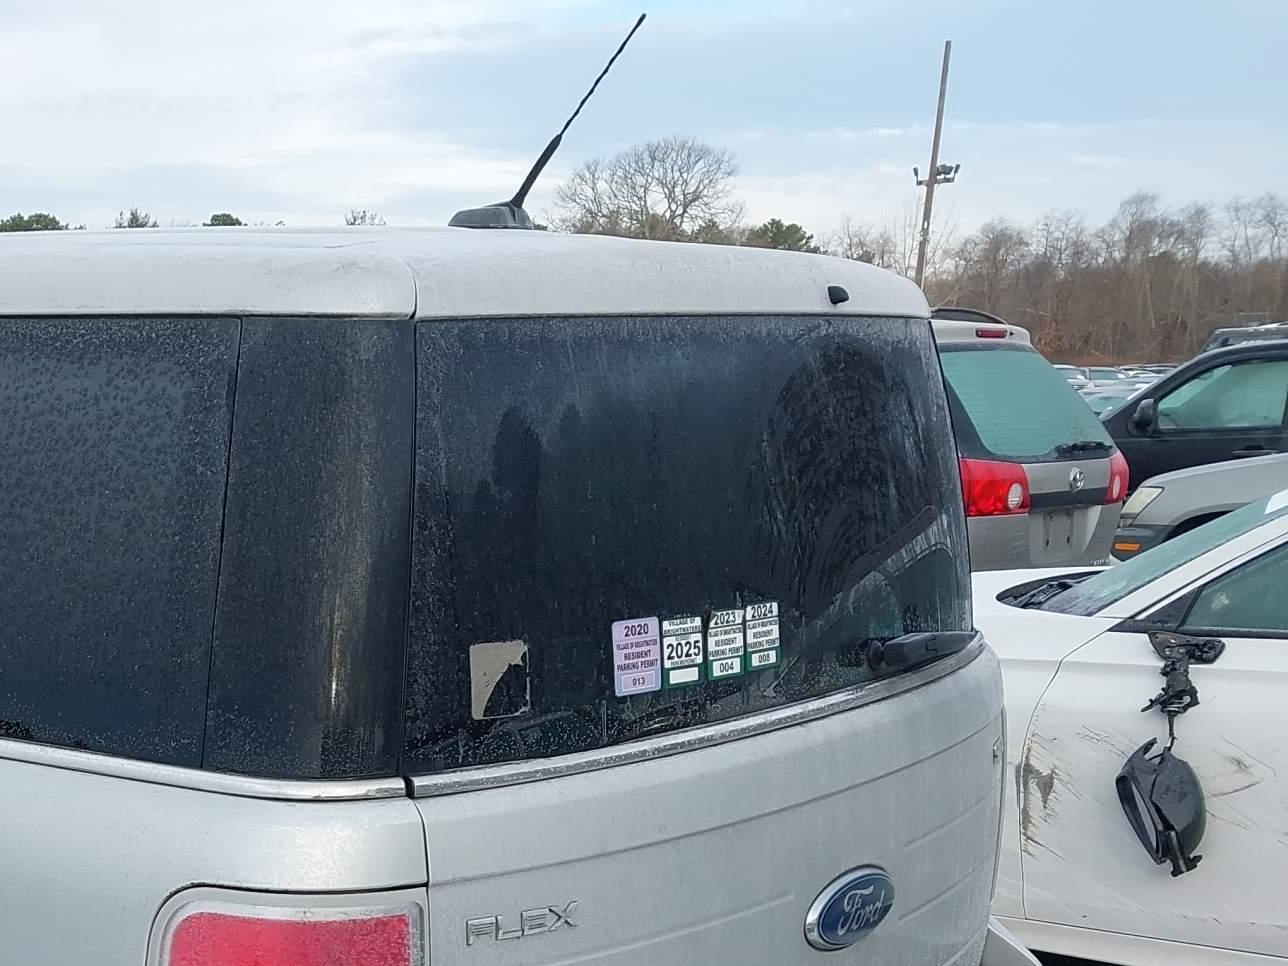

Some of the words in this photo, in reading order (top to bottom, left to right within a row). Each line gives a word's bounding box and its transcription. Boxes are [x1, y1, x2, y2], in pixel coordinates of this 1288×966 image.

[713, 611, 737, 625] 2023
[751, 604, 774, 618] 2024
[624, 623, 649, 637] 2020
[624, 650, 651, 660] RESIDENT
[666, 640, 701, 660] 2025
[616, 661, 639, 672] PARKING
[640, 658, 658, 668] PERMIT
[719, 661, 734, 672] 004
[632, 677, 645, 686] 013
[837, 884, 885, 936] Ford
[465, 899, 580, 946] FLEX
